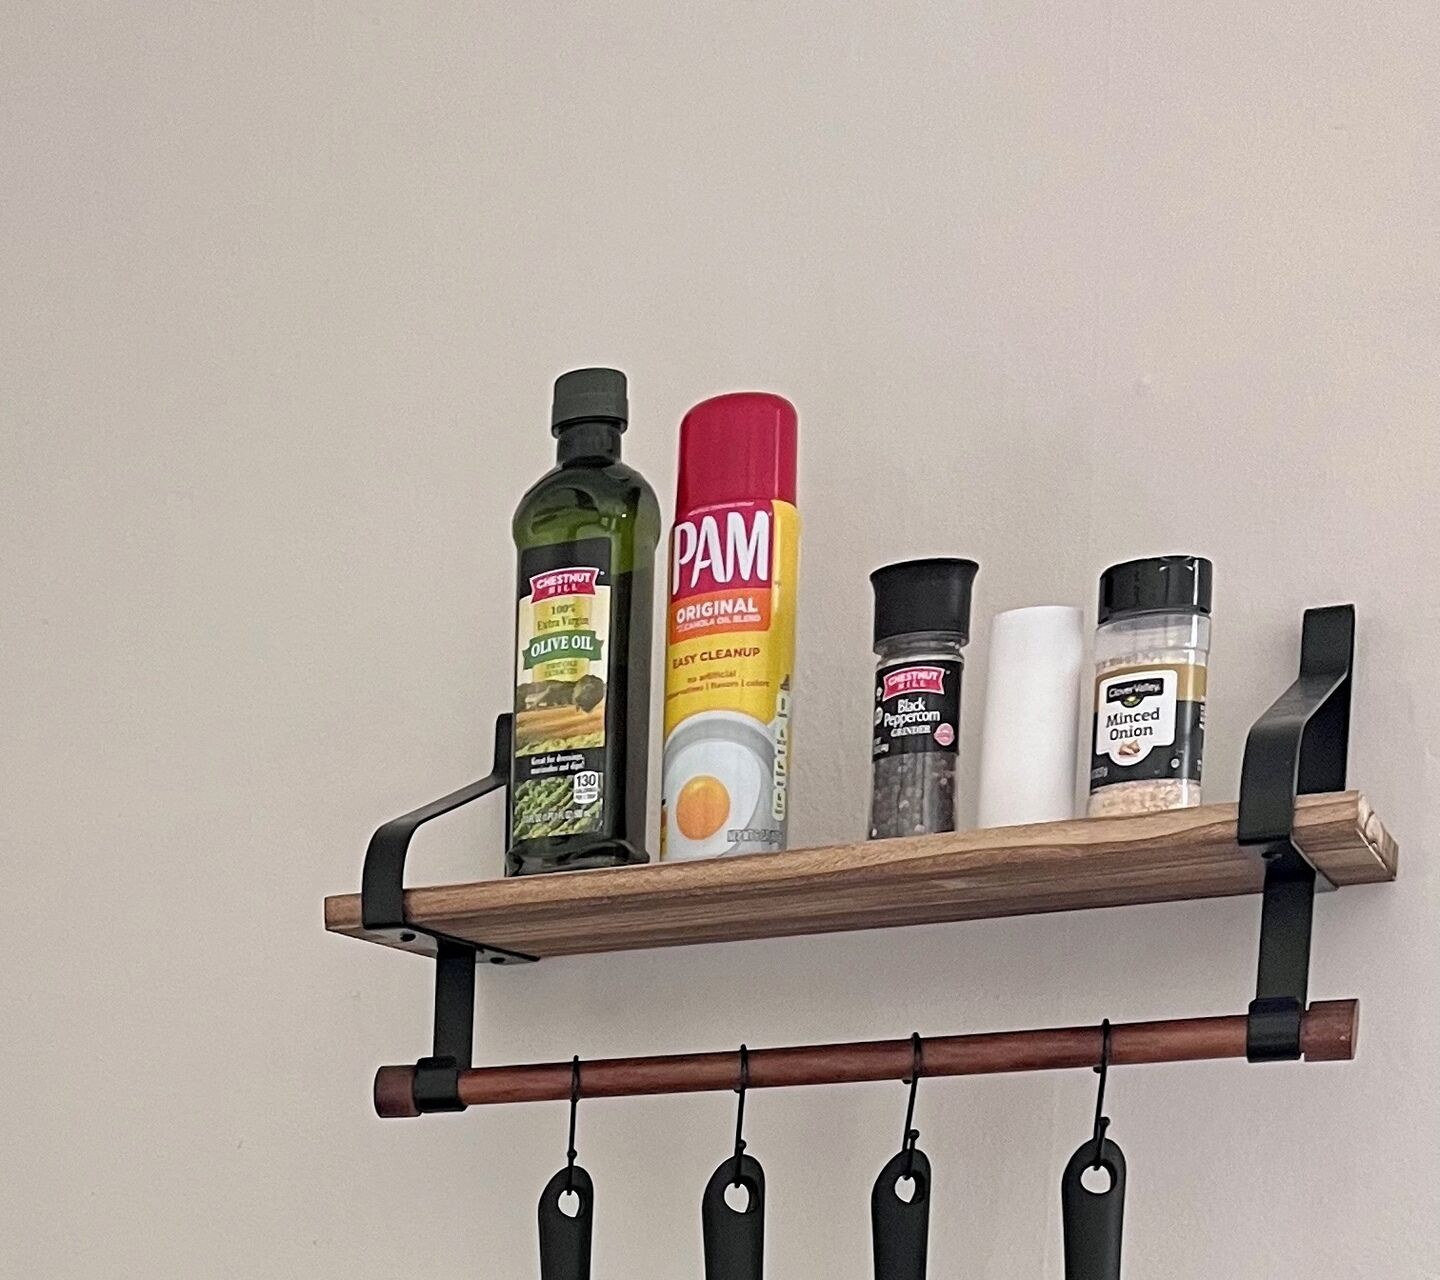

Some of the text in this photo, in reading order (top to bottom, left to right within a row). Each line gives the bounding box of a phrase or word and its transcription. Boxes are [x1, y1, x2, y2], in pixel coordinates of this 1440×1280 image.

[672, 510, 770, 595] PAM
[536, 572, 592, 589] CHESTNUT
[548, 584, 578, 595] HILL
[676, 597, 759, 624] ORIGINAL
[537, 615, 590, 631] Extra Virgin
[530, 635, 594, 657] OLIVE OIL
[672, 647, 761, 670] EASY CLEANUP
[888, 670, 939, 686] CHESTNUT
[897, 680, 927, 690] HILL
[897, 696, 926, 714] Black
[883, 711, 940, 728] Peppercorn
[1106, 707, 1160, 728] Minced
[890, 724, 931, 738] GRINDER
[1109, 725, 1154, 741] Onion
[576, 773, 597, 787] 130
